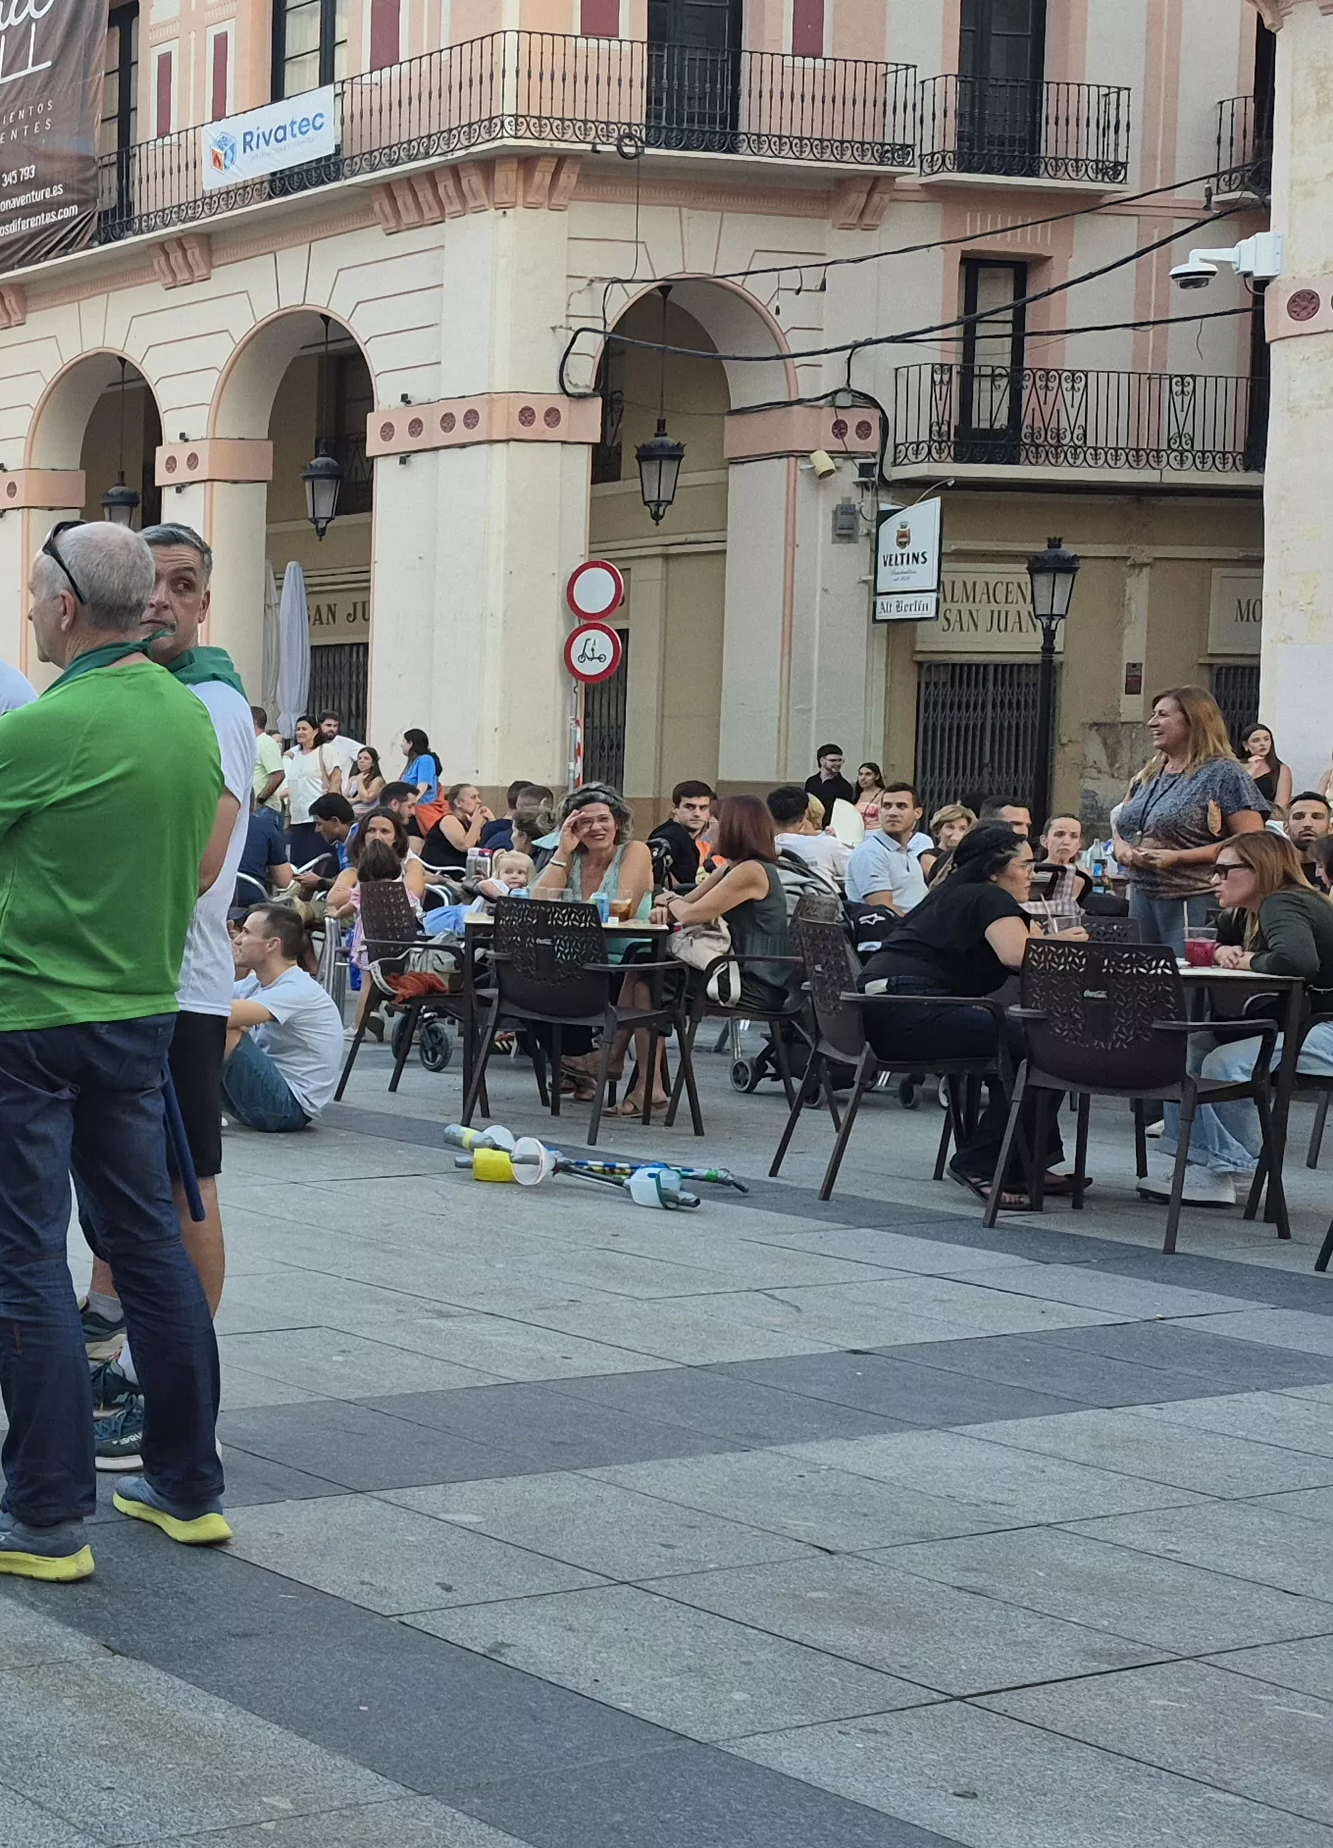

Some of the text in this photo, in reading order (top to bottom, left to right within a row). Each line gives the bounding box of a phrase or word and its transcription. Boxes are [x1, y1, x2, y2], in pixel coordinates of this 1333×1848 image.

[242, 112, 325, 154] Rivatec
[2, 170, 18, 187] 345
[19, 164, 36, 181] 793
[882, 551, 928, 567] VELTINS
[941, 580, 1034, 605] ALMACEN
[942, 608, 1037, 633] SAN JUAN
